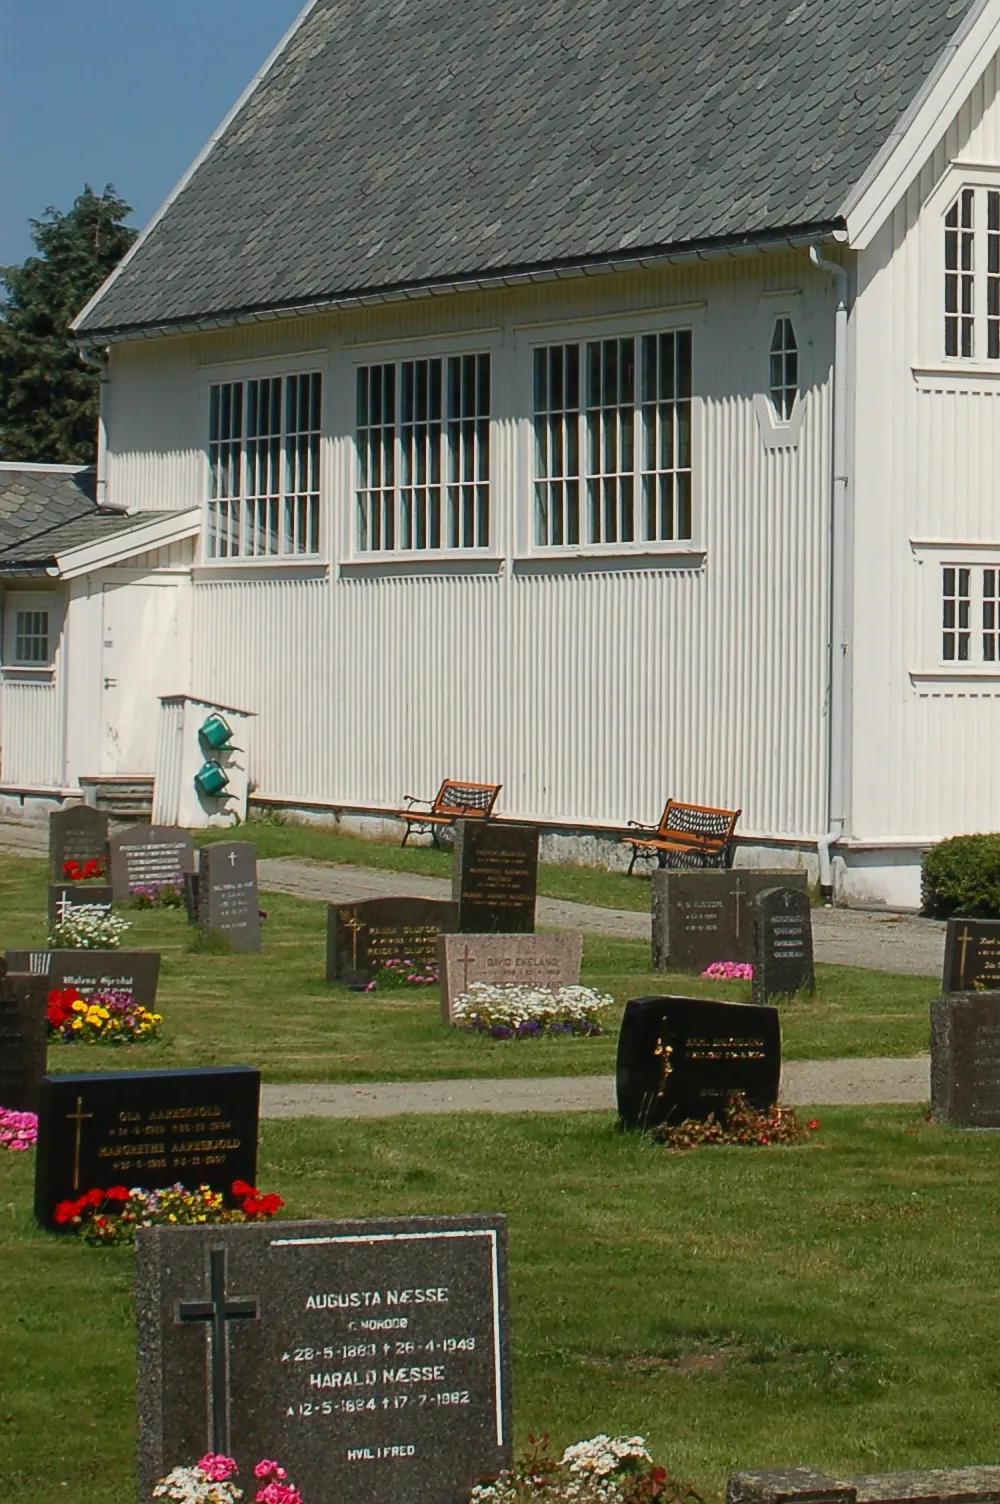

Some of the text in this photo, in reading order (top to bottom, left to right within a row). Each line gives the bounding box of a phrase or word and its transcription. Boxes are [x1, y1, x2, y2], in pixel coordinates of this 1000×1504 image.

[305, 1287, 449, 1309] AUGUSTA NÆSSE
[309, 1365, 445, 1389] HARALD NÆSSE
[347, 1448, 374, 1461] HVIL
[383, 1445, 416, 1458] FRED
